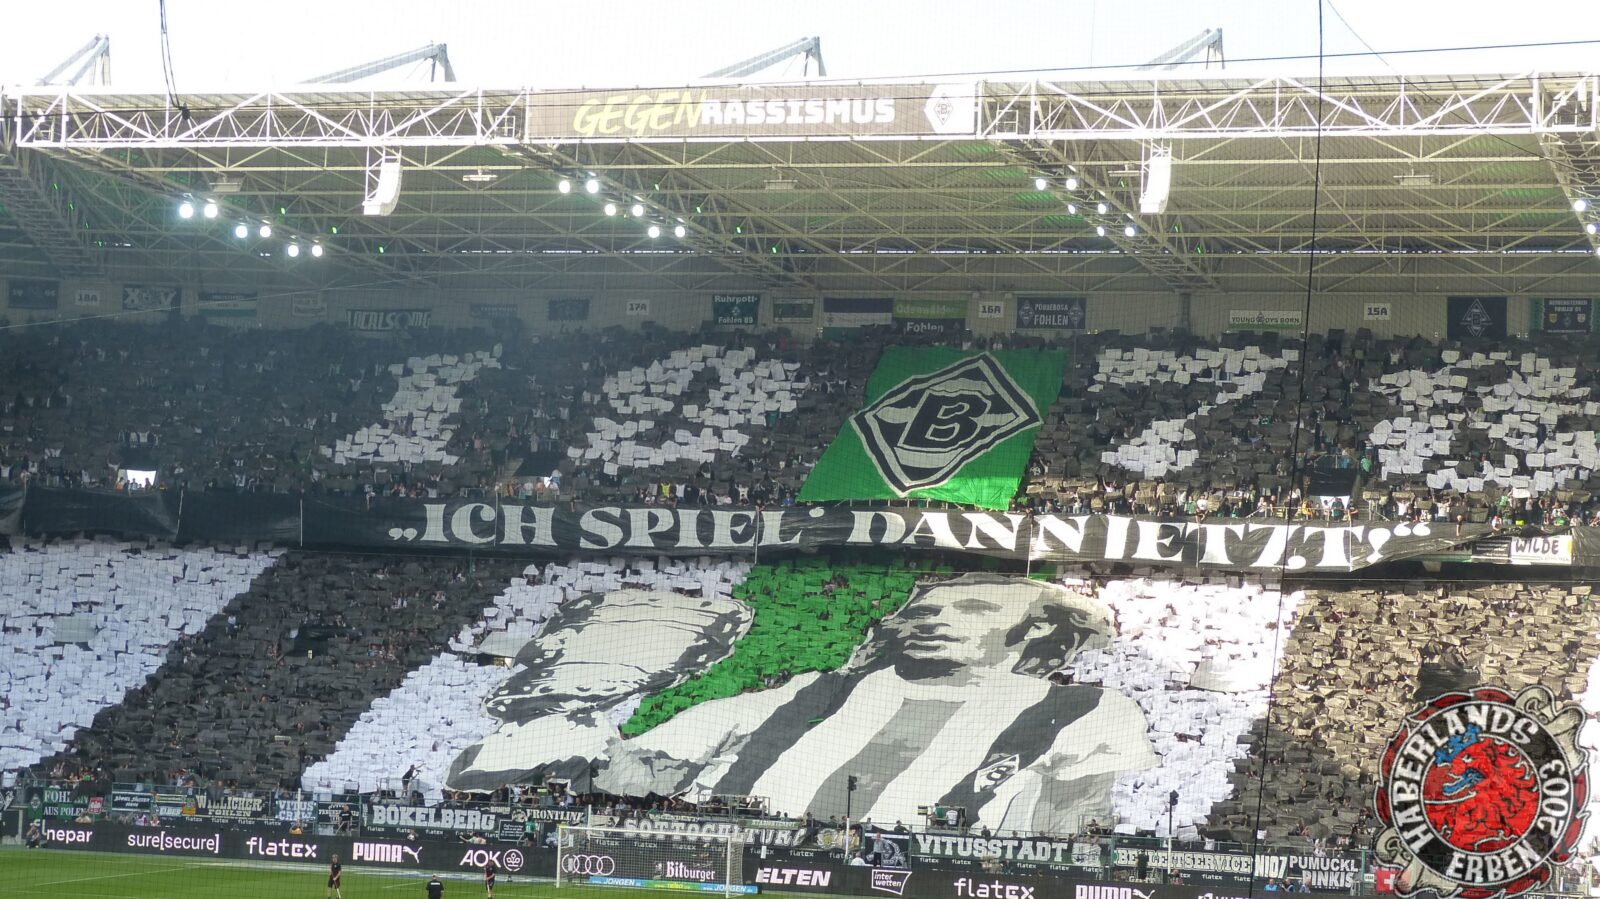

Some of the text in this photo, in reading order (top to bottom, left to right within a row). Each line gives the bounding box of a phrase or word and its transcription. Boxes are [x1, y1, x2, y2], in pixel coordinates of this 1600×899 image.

[572, 89, 895, 137] GEGEN RASSISMUS
[628, 303, 647, 312] 17A
[981, 305, 1001, 313] 16A
[1367, 307, 1388, 316] 15A
[718, 316, 742, 324] Fohlen
[907, 321, 945, 334] Fohlen
[1033, 314, 1069, 326] FOHLEN
[846, 510, 1090, 553] DANN
[1515, 539, 1559, 554] WILDE
[43, 806, 59, 816] AUS
[196, 795, 263, 812] WILLICHER
[280, 800, 314, 811] VITUS
[373, 804, 496, 831] BÖKELBERG
[127, 831, 220, 854] sure[secure]
[246, 837, 317, 858] flatex
[915, 834, 1068, 862] VITUSSTADT
[353, 842, 402, 863] PUMA
[459, 849, 502, 868] AOK
[1116, 848, 1253, 873] BELEITSERVICE
[666, 861, 716, 882] Bitburger
[1289, 856, 1358, 872] PUMUCKL
[755, 867, 831, 887] ELTEN
[873, 872, 893, 880] inter
[875, 879, 902, 887] wetten
[953, 878, 1035, 899] flatex
